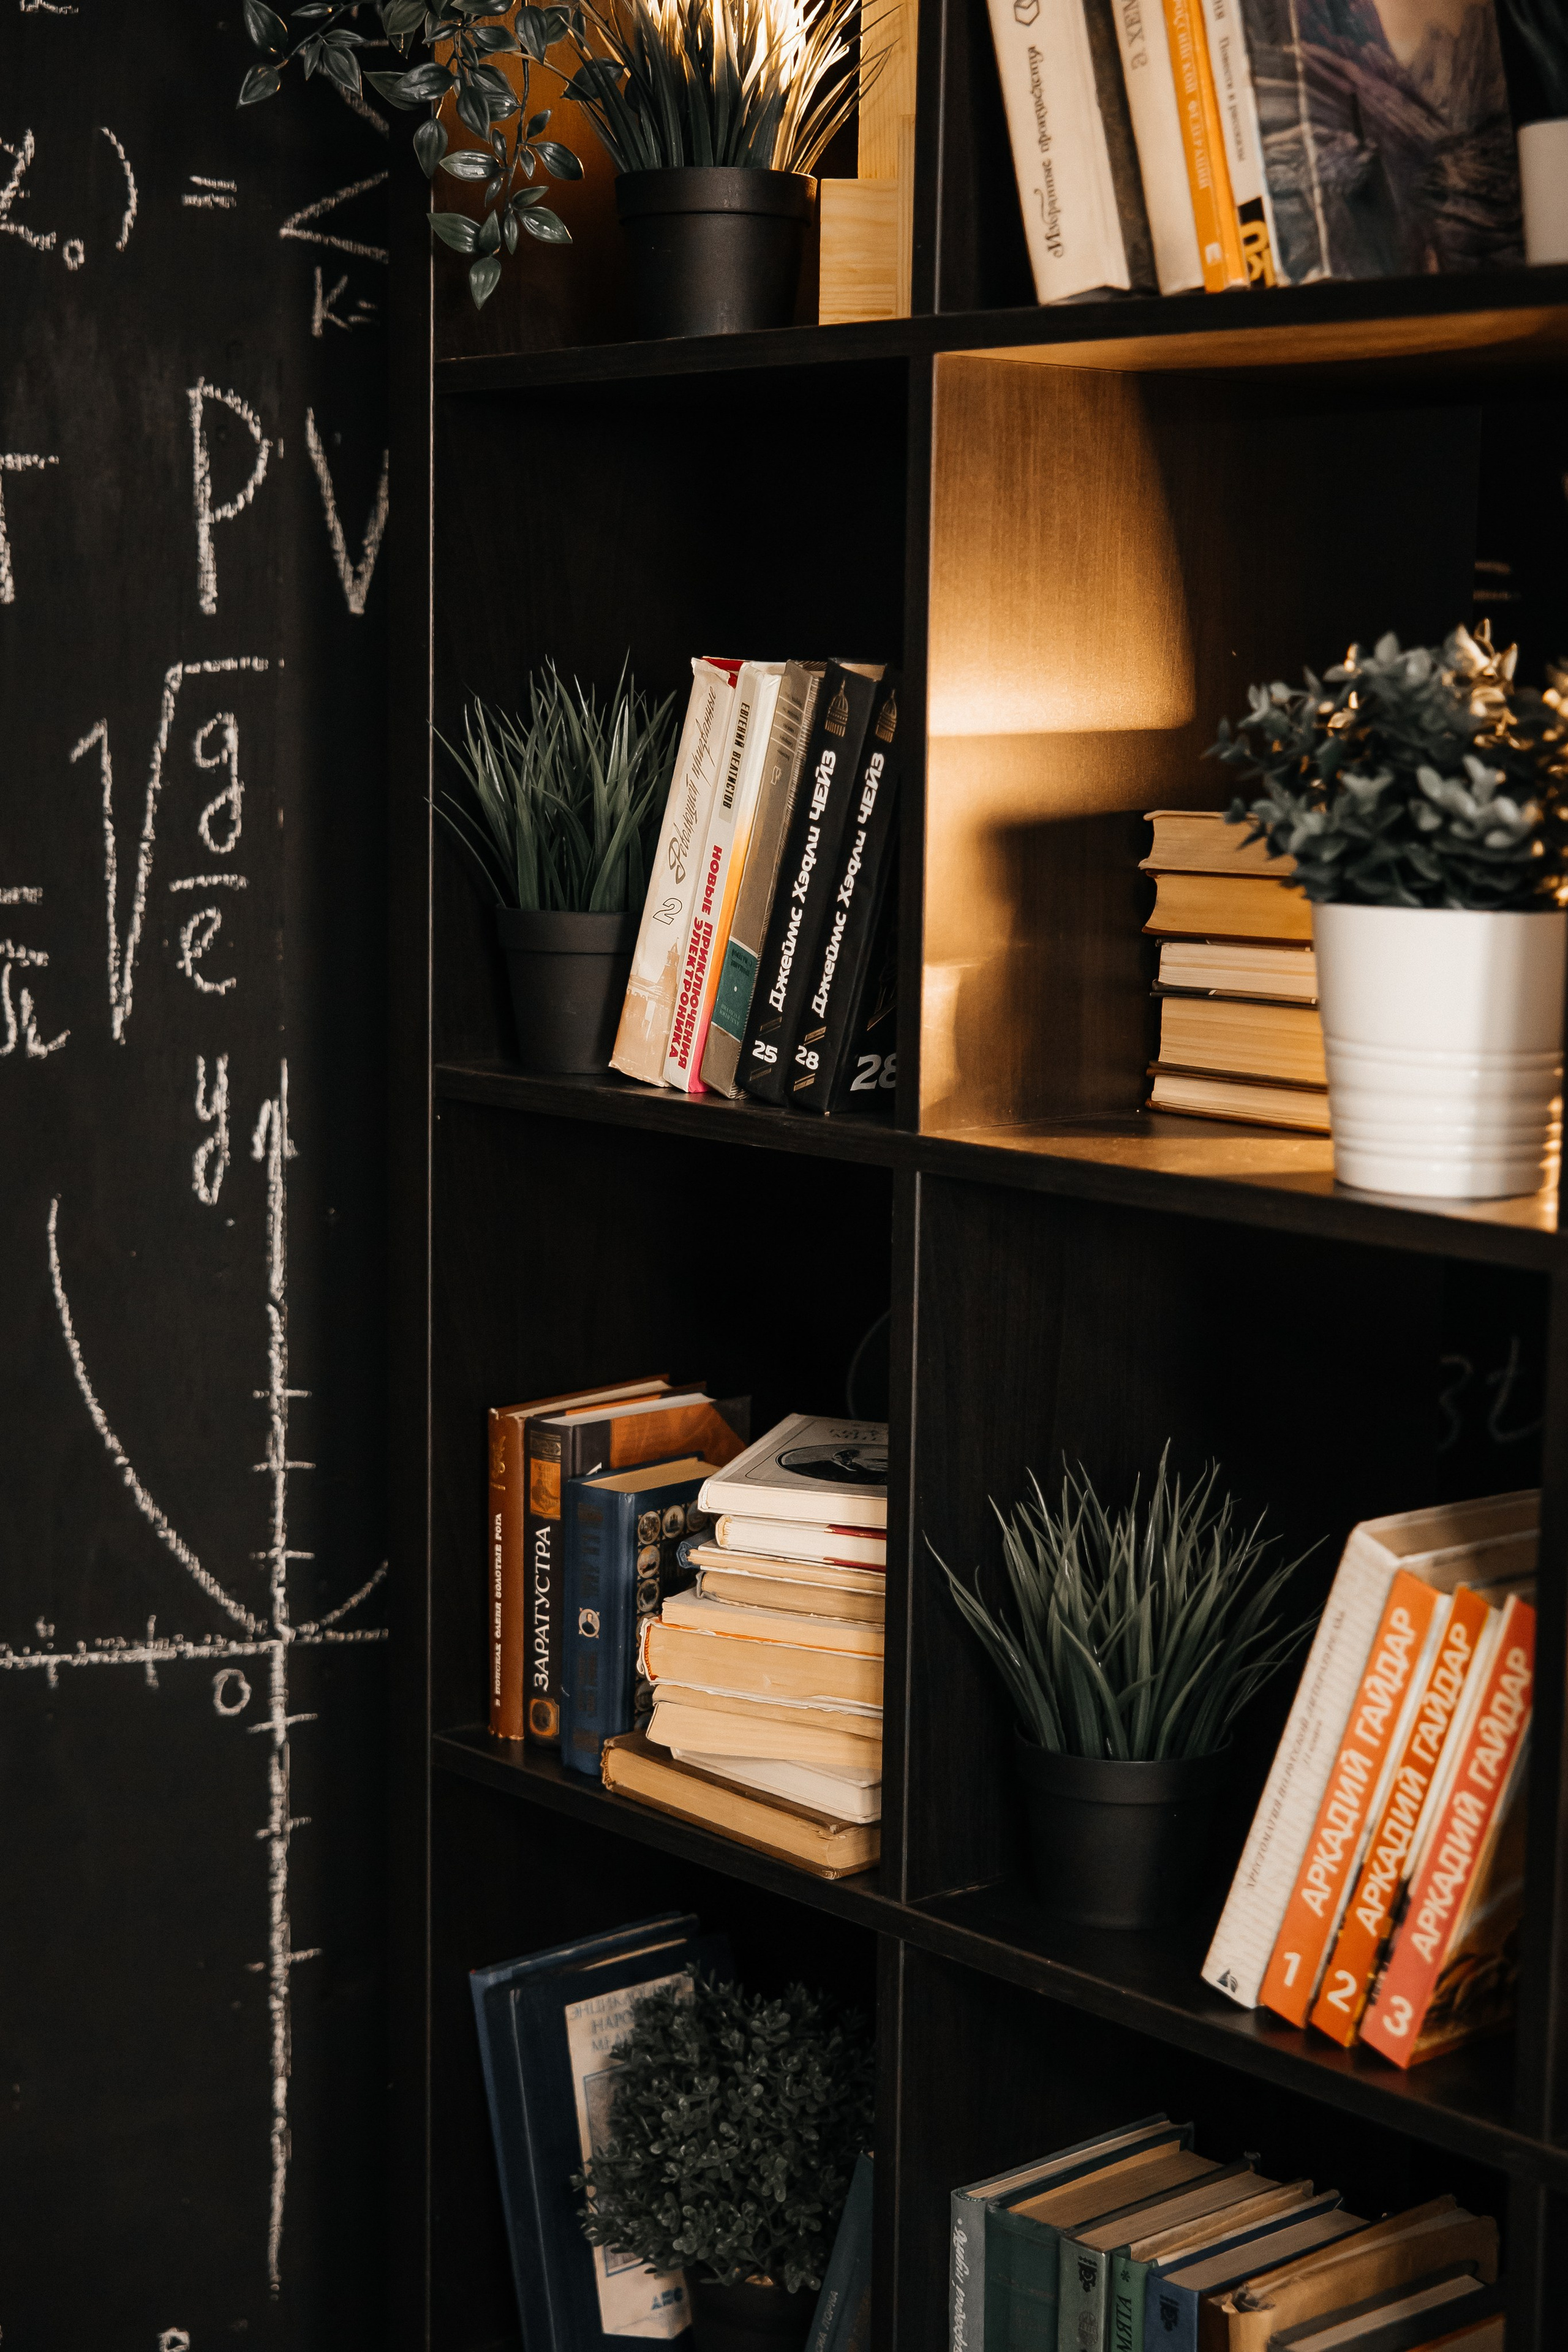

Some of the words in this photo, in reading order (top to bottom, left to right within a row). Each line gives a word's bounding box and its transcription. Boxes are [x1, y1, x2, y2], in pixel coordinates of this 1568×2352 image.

[1033, 158, 1065, 258] Избранные
[734, 701, 751, 749] ЕВГЕНИЙ
[669, 773, 700, 884] Революцией
[693, 686, 716, 787] призванные
[723, 750, 742, 809] ВЕЛТИСТОВ
[653, 898, 682, 925] 2
[702, 845, 722, 916] НОВЫЕ
[769, 907, 803, 1012] Джеймс
[792, 826, 821, 903] Хэдли
[810, 750, 837, 821] ЧЕЙЗ
[810, 911, 846, 1019] Джеймс
[837, 830, 866, 908] Хэдли
[858, 752, 885, 826] ЧЕЙЗ
[670, 916, 704, 1058] ЭЛЕКТРОНИКА
[677, 920, 713, 1070] ПРИКЛЮЧЕНИЯ
[752, 1040, 778, 1063] 25
[794, 1045, 820, 1070] 28
[533, 1525, 551, 1692] ЗАРАТУСТРА
[1300, 1749, 1374, 1918] АРКАДИЙ
[1355, 1606, 1416, 1747] ГАЙДАР
[1354, 1766, 1428, 1937] АРКАДИЙ
[1411, 1622, 1471, 1764] ГАЙДАР
[1410, 1790, 1487, 1963] АРКАДИЙ
[1468, 1646, 1531, 1790] ГАЙДАР
[1282, 1951, 1302, 1987] 1
[1326, 1970, 1358, 2013] 2
[1381, 1996, 1414, 2038] 3
